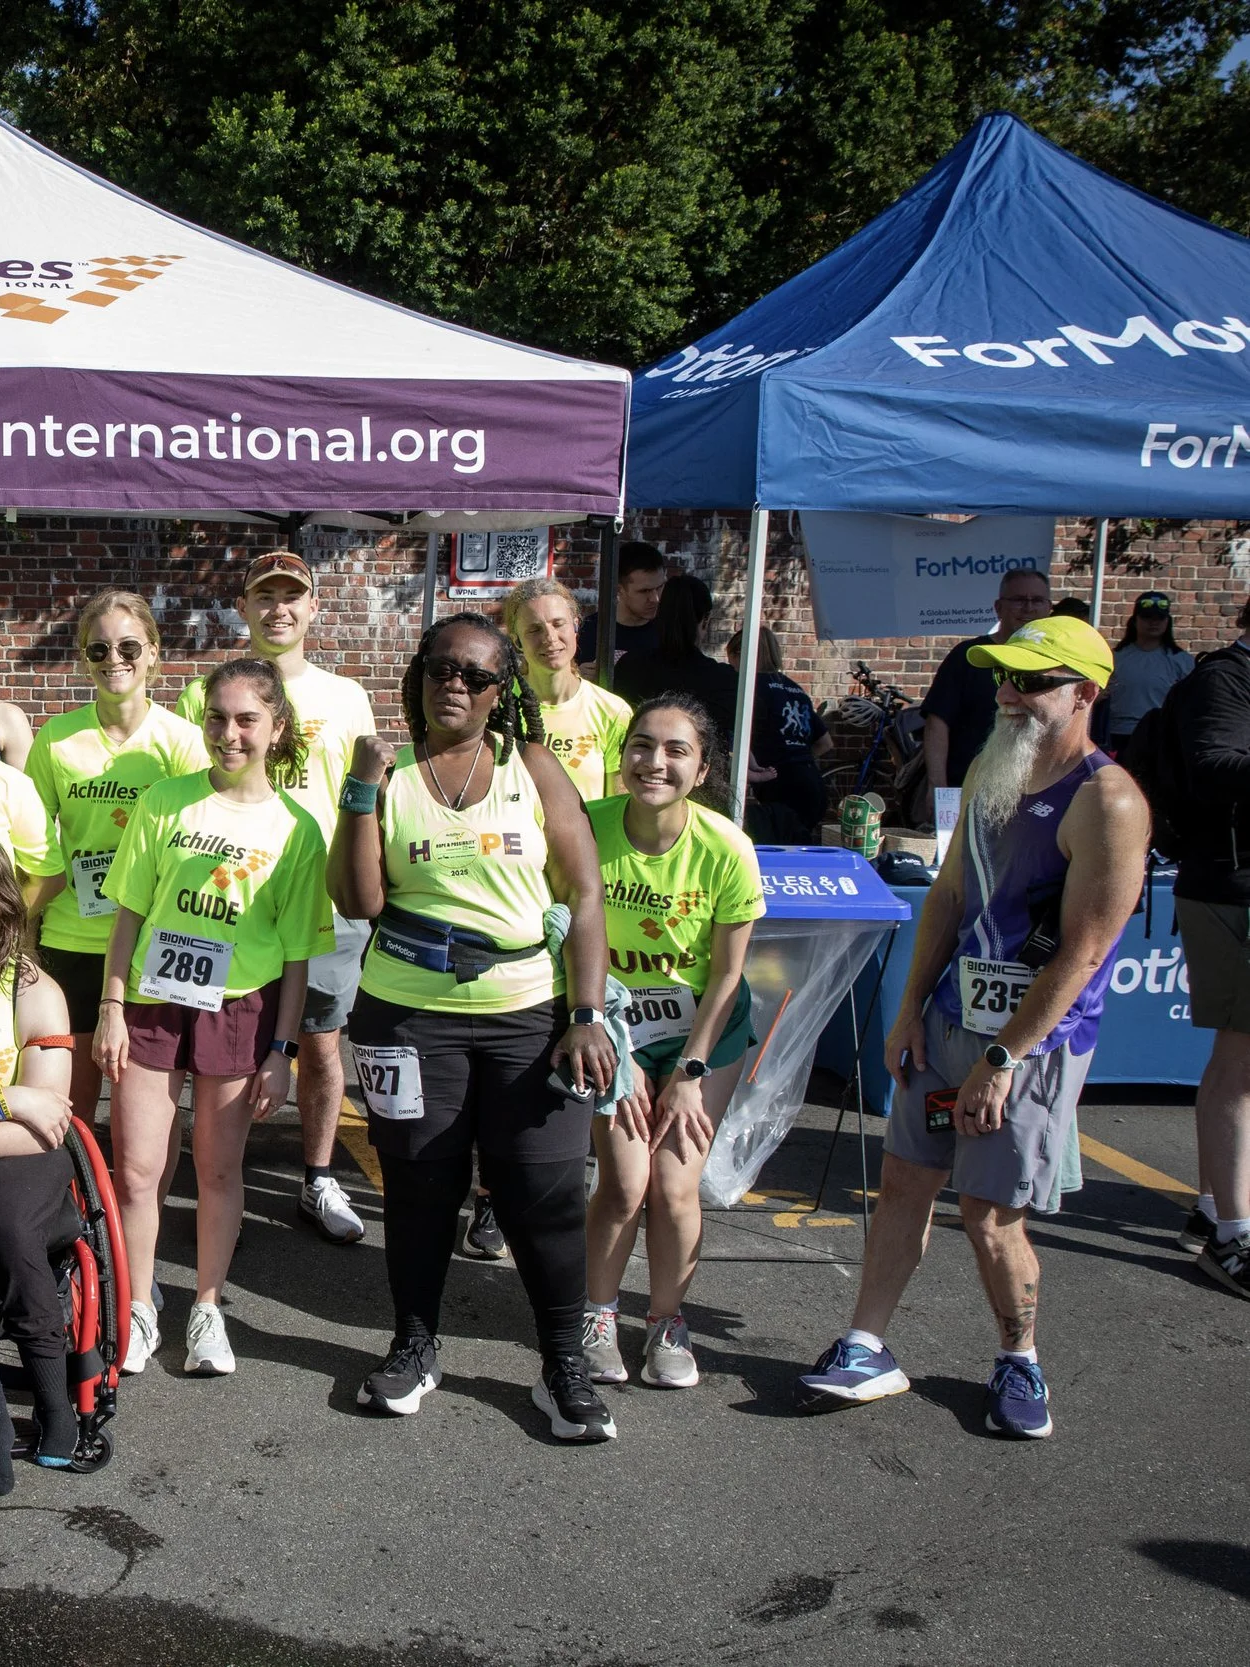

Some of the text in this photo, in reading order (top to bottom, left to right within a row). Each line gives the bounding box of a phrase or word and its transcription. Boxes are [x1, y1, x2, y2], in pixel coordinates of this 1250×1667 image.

[915, 554, 1037, 577] ForMotion
[926, 609, 950, 617] Global
[969, 616, 997, 624] Patient
[67, 780, 139, 800] Achilles
[167, 831, 247, 860] Achilles
[190, 850, 241, 867] INTERNATIONAL
[450, 868, 469, 877] 2025
[819, 876, 835, 886] &
[781, 886, 838, 896] ONLY
[177, 888, 240, 926] GUIDE
[159, 931, 214, 952] BIONIC
[386, 940, 418, 959] ForMotion
[156, 948, 214, 987] 289
[967, 960, 1029, 977] BIONIC
[143, 987, 216, 1009] FOOD DRINK DRINK
[971, 977, 1031, 1013] 235
[624, 998, 682, 1027] 800
[360, 1062, 401, 1096] 927
